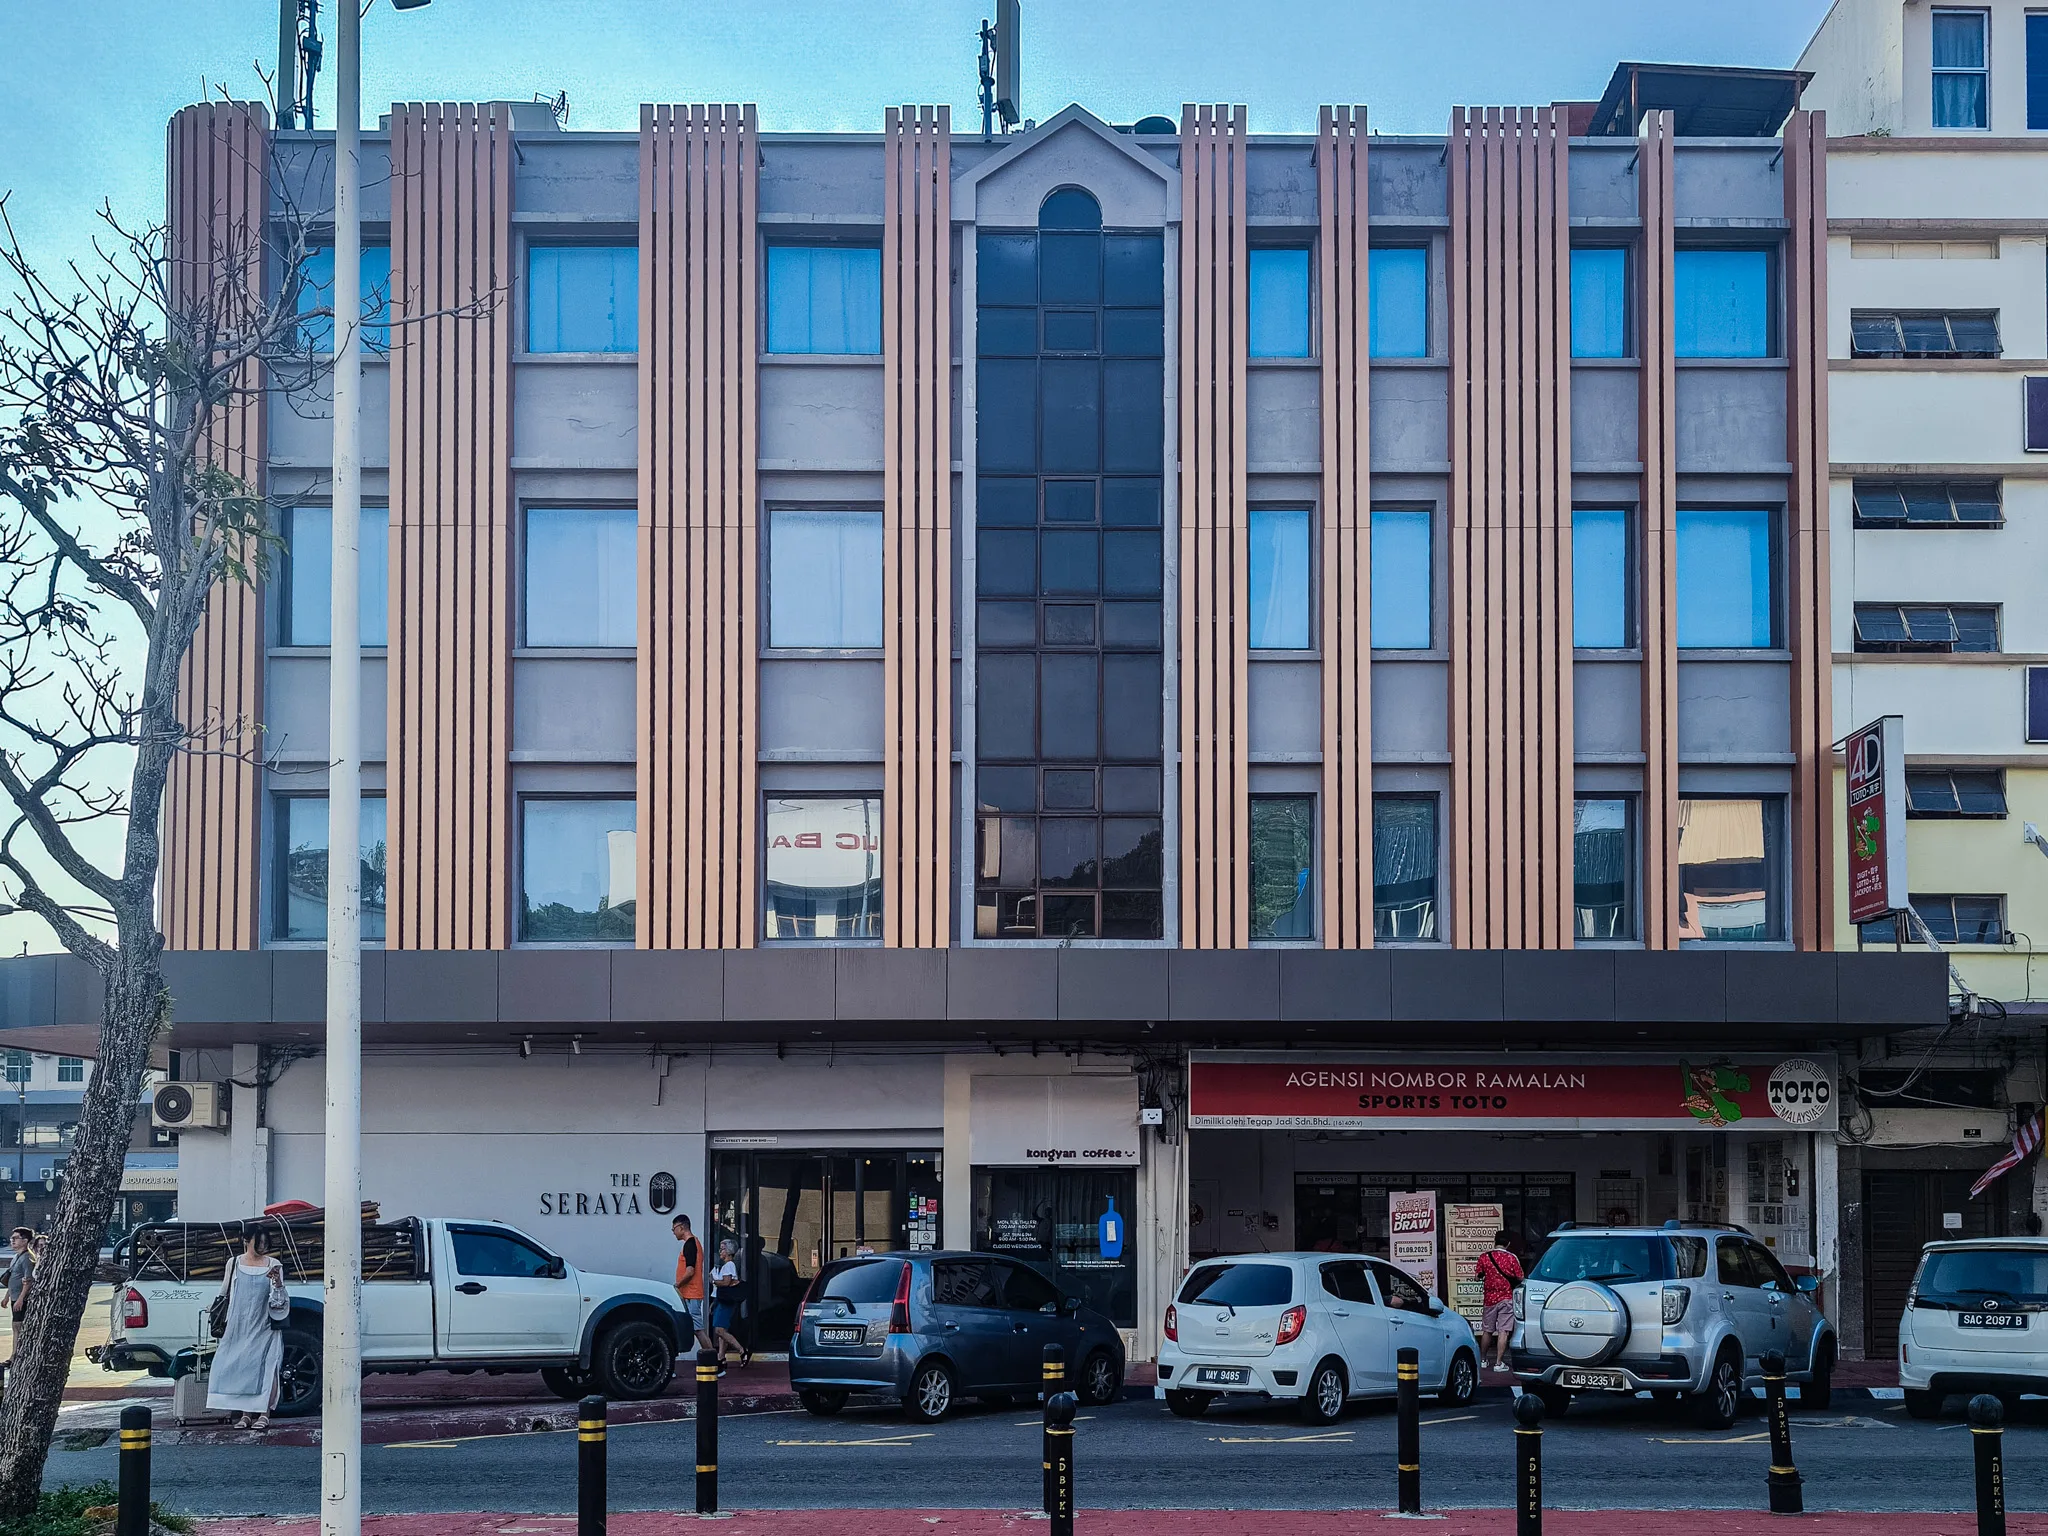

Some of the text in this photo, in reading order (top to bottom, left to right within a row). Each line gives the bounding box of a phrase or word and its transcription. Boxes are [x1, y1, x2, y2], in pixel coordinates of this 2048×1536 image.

[1850, 734, 1881, 783] 4D
[1783, 1060, 1814, 1073] SPORTS
[1286, 1072, 1586, 1088] AGENSI NOMBOR RAMALAN
[1769, 1080, 1830, 1104] TOTO
[1358, 1095, 1508, 1109] SPORTS TOTO
[1195, 1116, 1224, 1125] Dimiliki
[1246, 1117, 1272, 1127] Tegap
[1276, 1117, 1292, 1126] Jadi
[1778, 1108, 1820, 1122] MALAYSIA
[1026, 1149, 1122, 1162] kongyan coffee
[610, 1174, 640, 1187] THE
[540, 1192, 642, 1215] SERAYA
[1395, 1208, 1430, 1222] Special
[1394, 1218, 1431, 1232] DRAW
[1964, 1314, 2022, 1326] SAC 2097 B
[1206, 1370, 1240, 1380] VAY 9485
[1570, 1375, 1616, 1386] SAB 3235 Y
[1529, 1463, 1537, 1510] DBKK
[1992, 1464, 2001, 1508] DBKK
